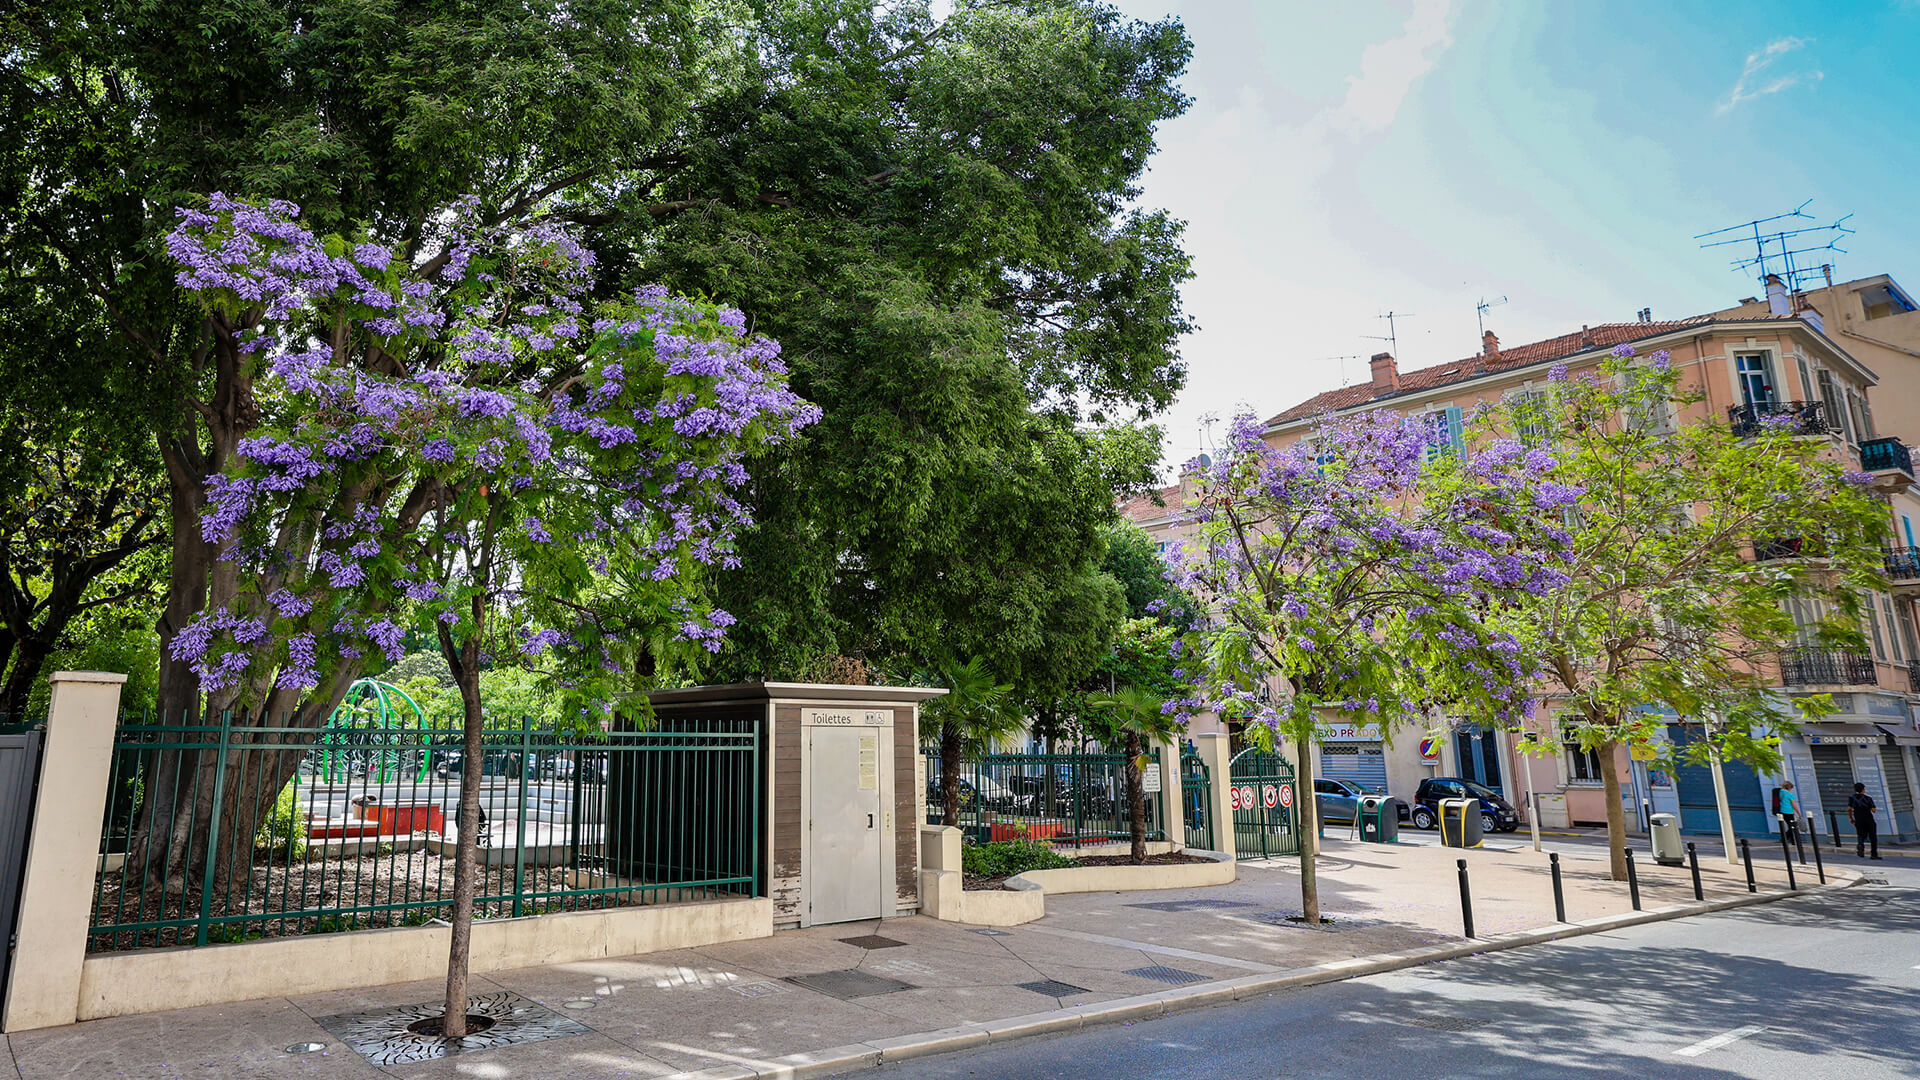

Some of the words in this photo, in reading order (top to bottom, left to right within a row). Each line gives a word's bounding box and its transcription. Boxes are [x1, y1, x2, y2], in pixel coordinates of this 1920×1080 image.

[811, 713, 851, 724] Toilettes
[1340, 729, 1376, 737] PRADO
[1823, 736, 1834, 744] 04
[1856, 736, 1867, 744] 00
